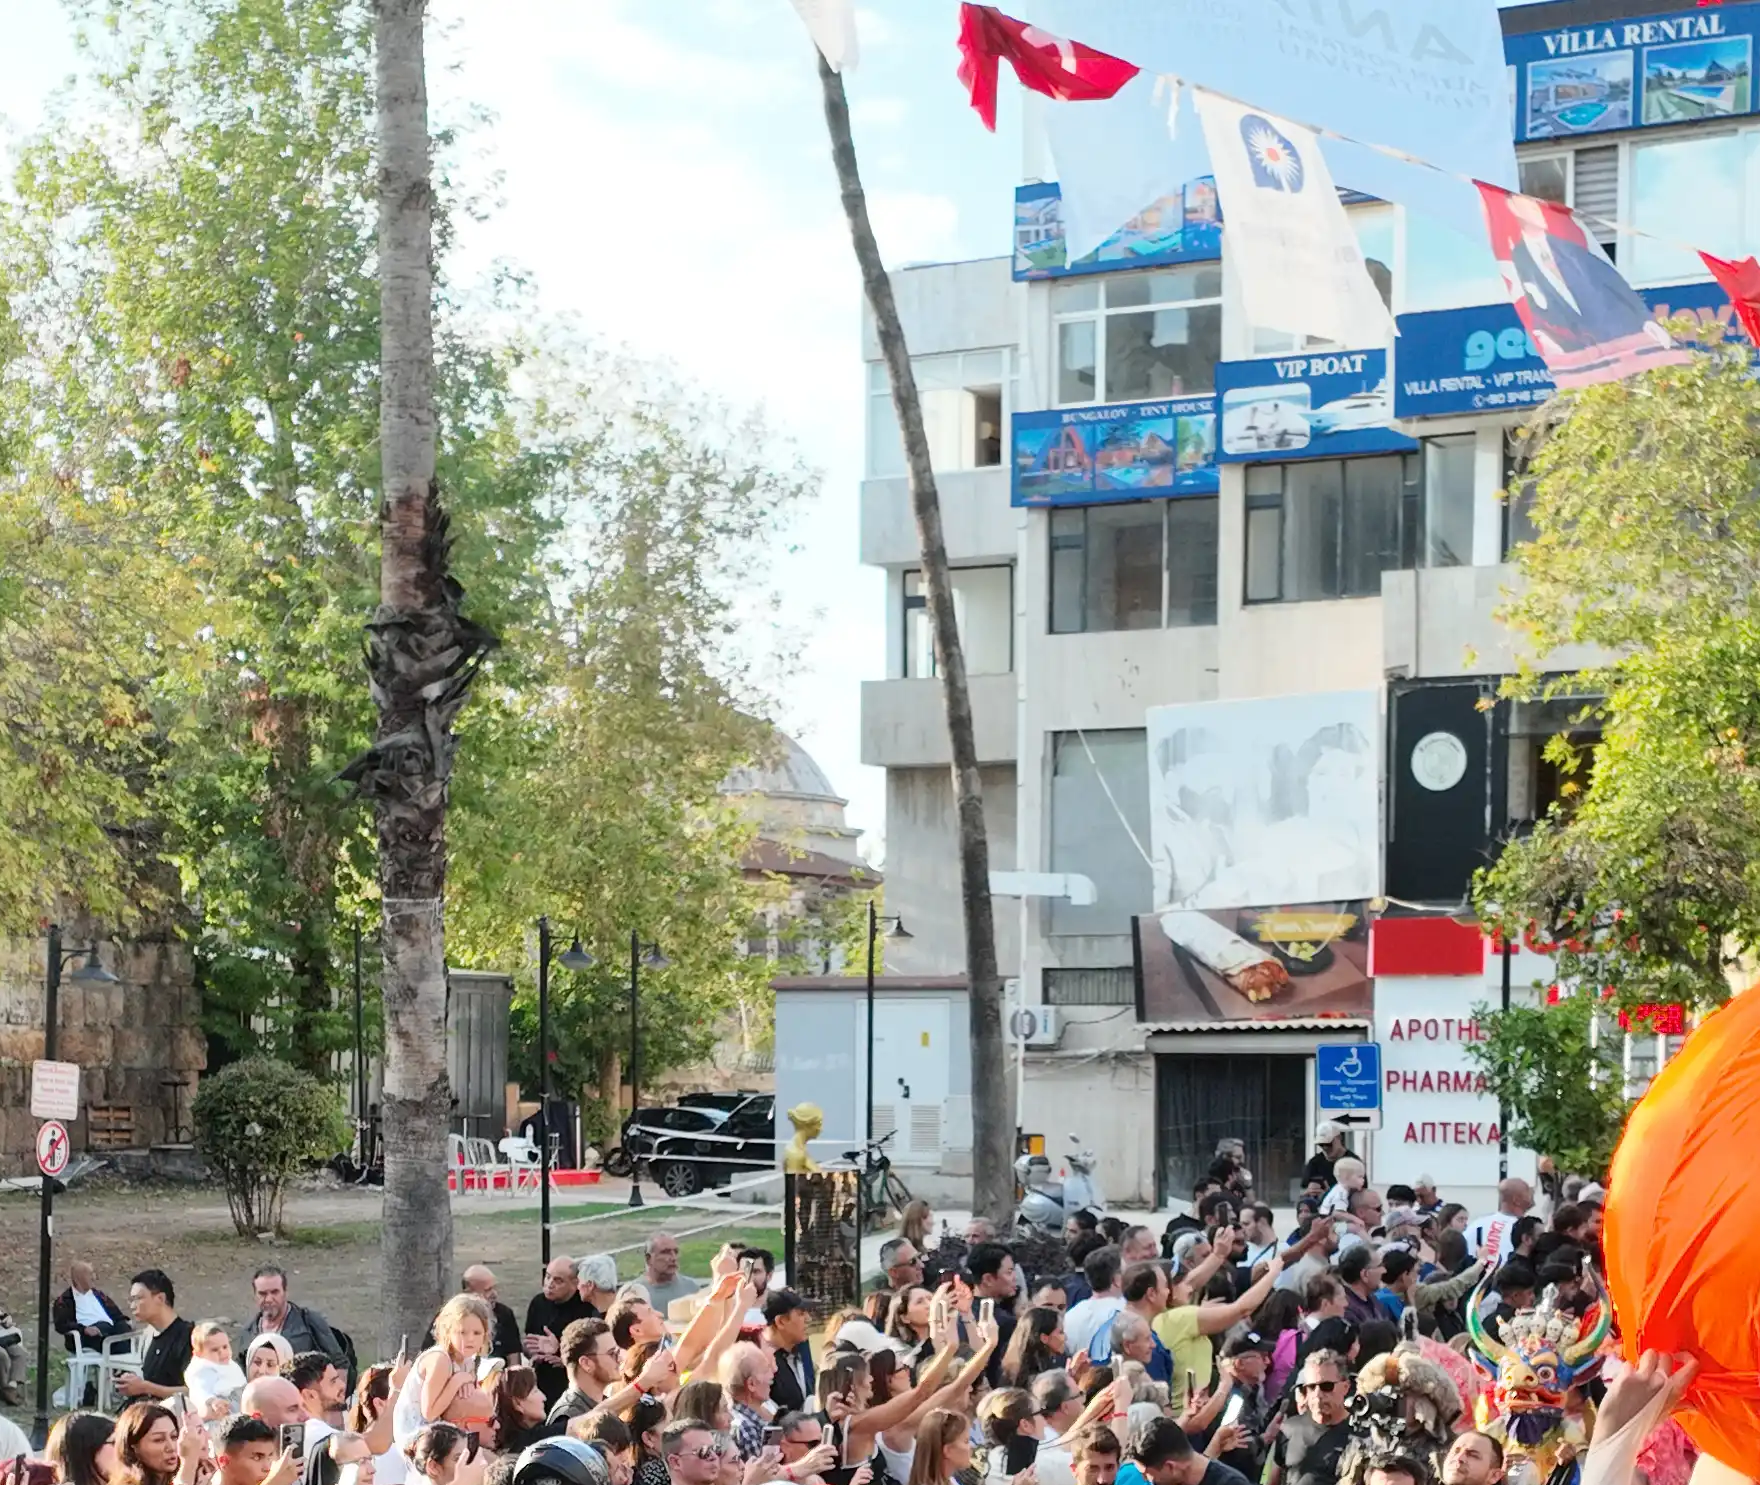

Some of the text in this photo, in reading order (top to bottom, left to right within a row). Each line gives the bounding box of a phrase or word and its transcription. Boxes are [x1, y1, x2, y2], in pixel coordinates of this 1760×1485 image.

[1623, 14, 1726, 46] RENTAL
[1273, 353, 1367, 379] VIP BOAT
[1386, 1070, 1490, 1093] PHARMA
[1403, 1121, 1501, 1145] АПТЕКА
